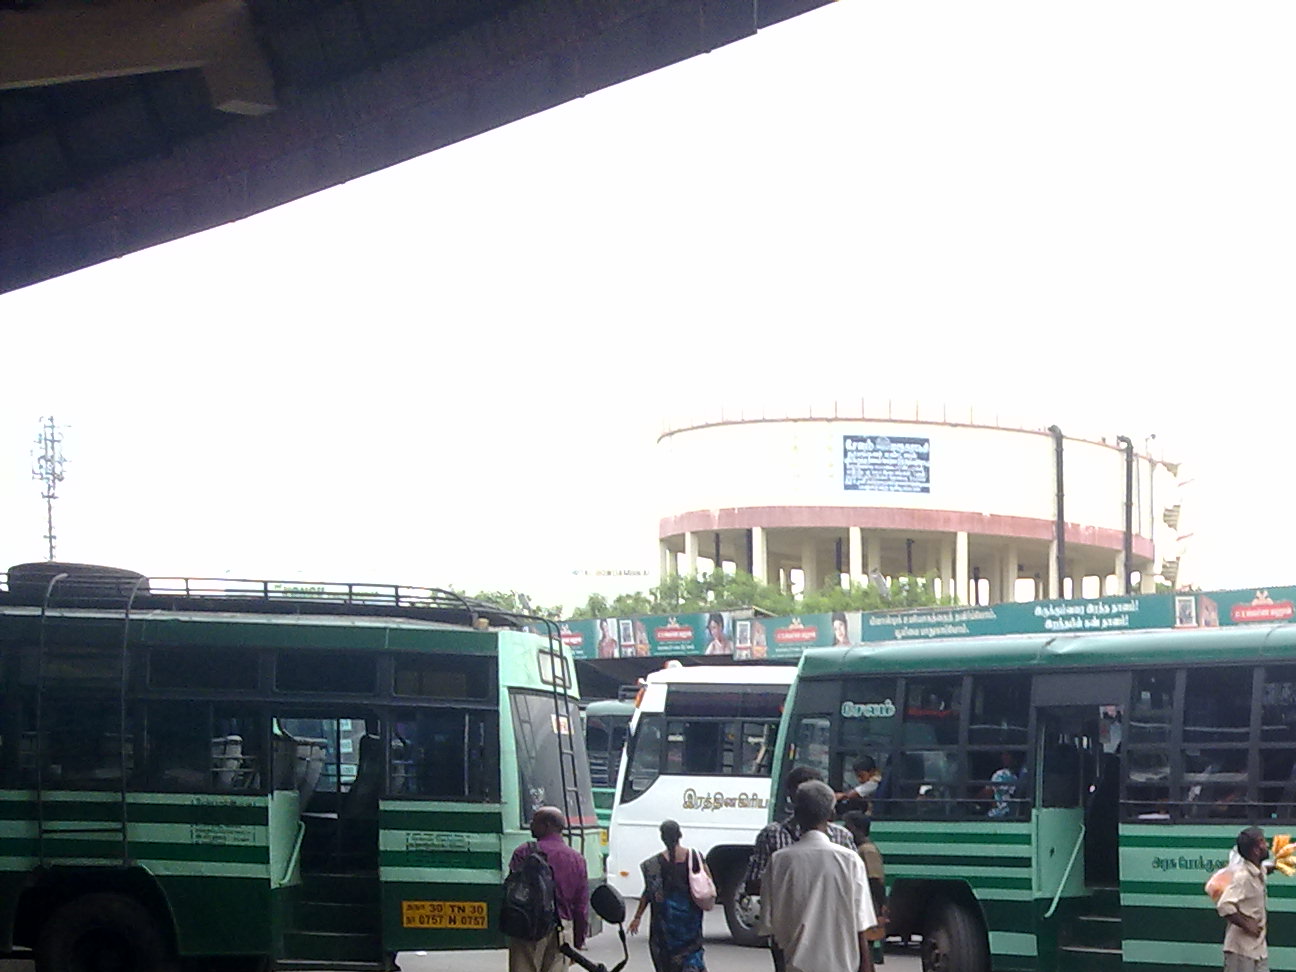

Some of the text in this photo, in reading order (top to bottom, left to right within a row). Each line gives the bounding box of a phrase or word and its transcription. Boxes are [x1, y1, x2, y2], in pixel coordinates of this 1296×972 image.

[449, 904, 484, 915] TN 30
[418, 915, 444, 925] 0757
[448, 915, 486, 926] N 0757
